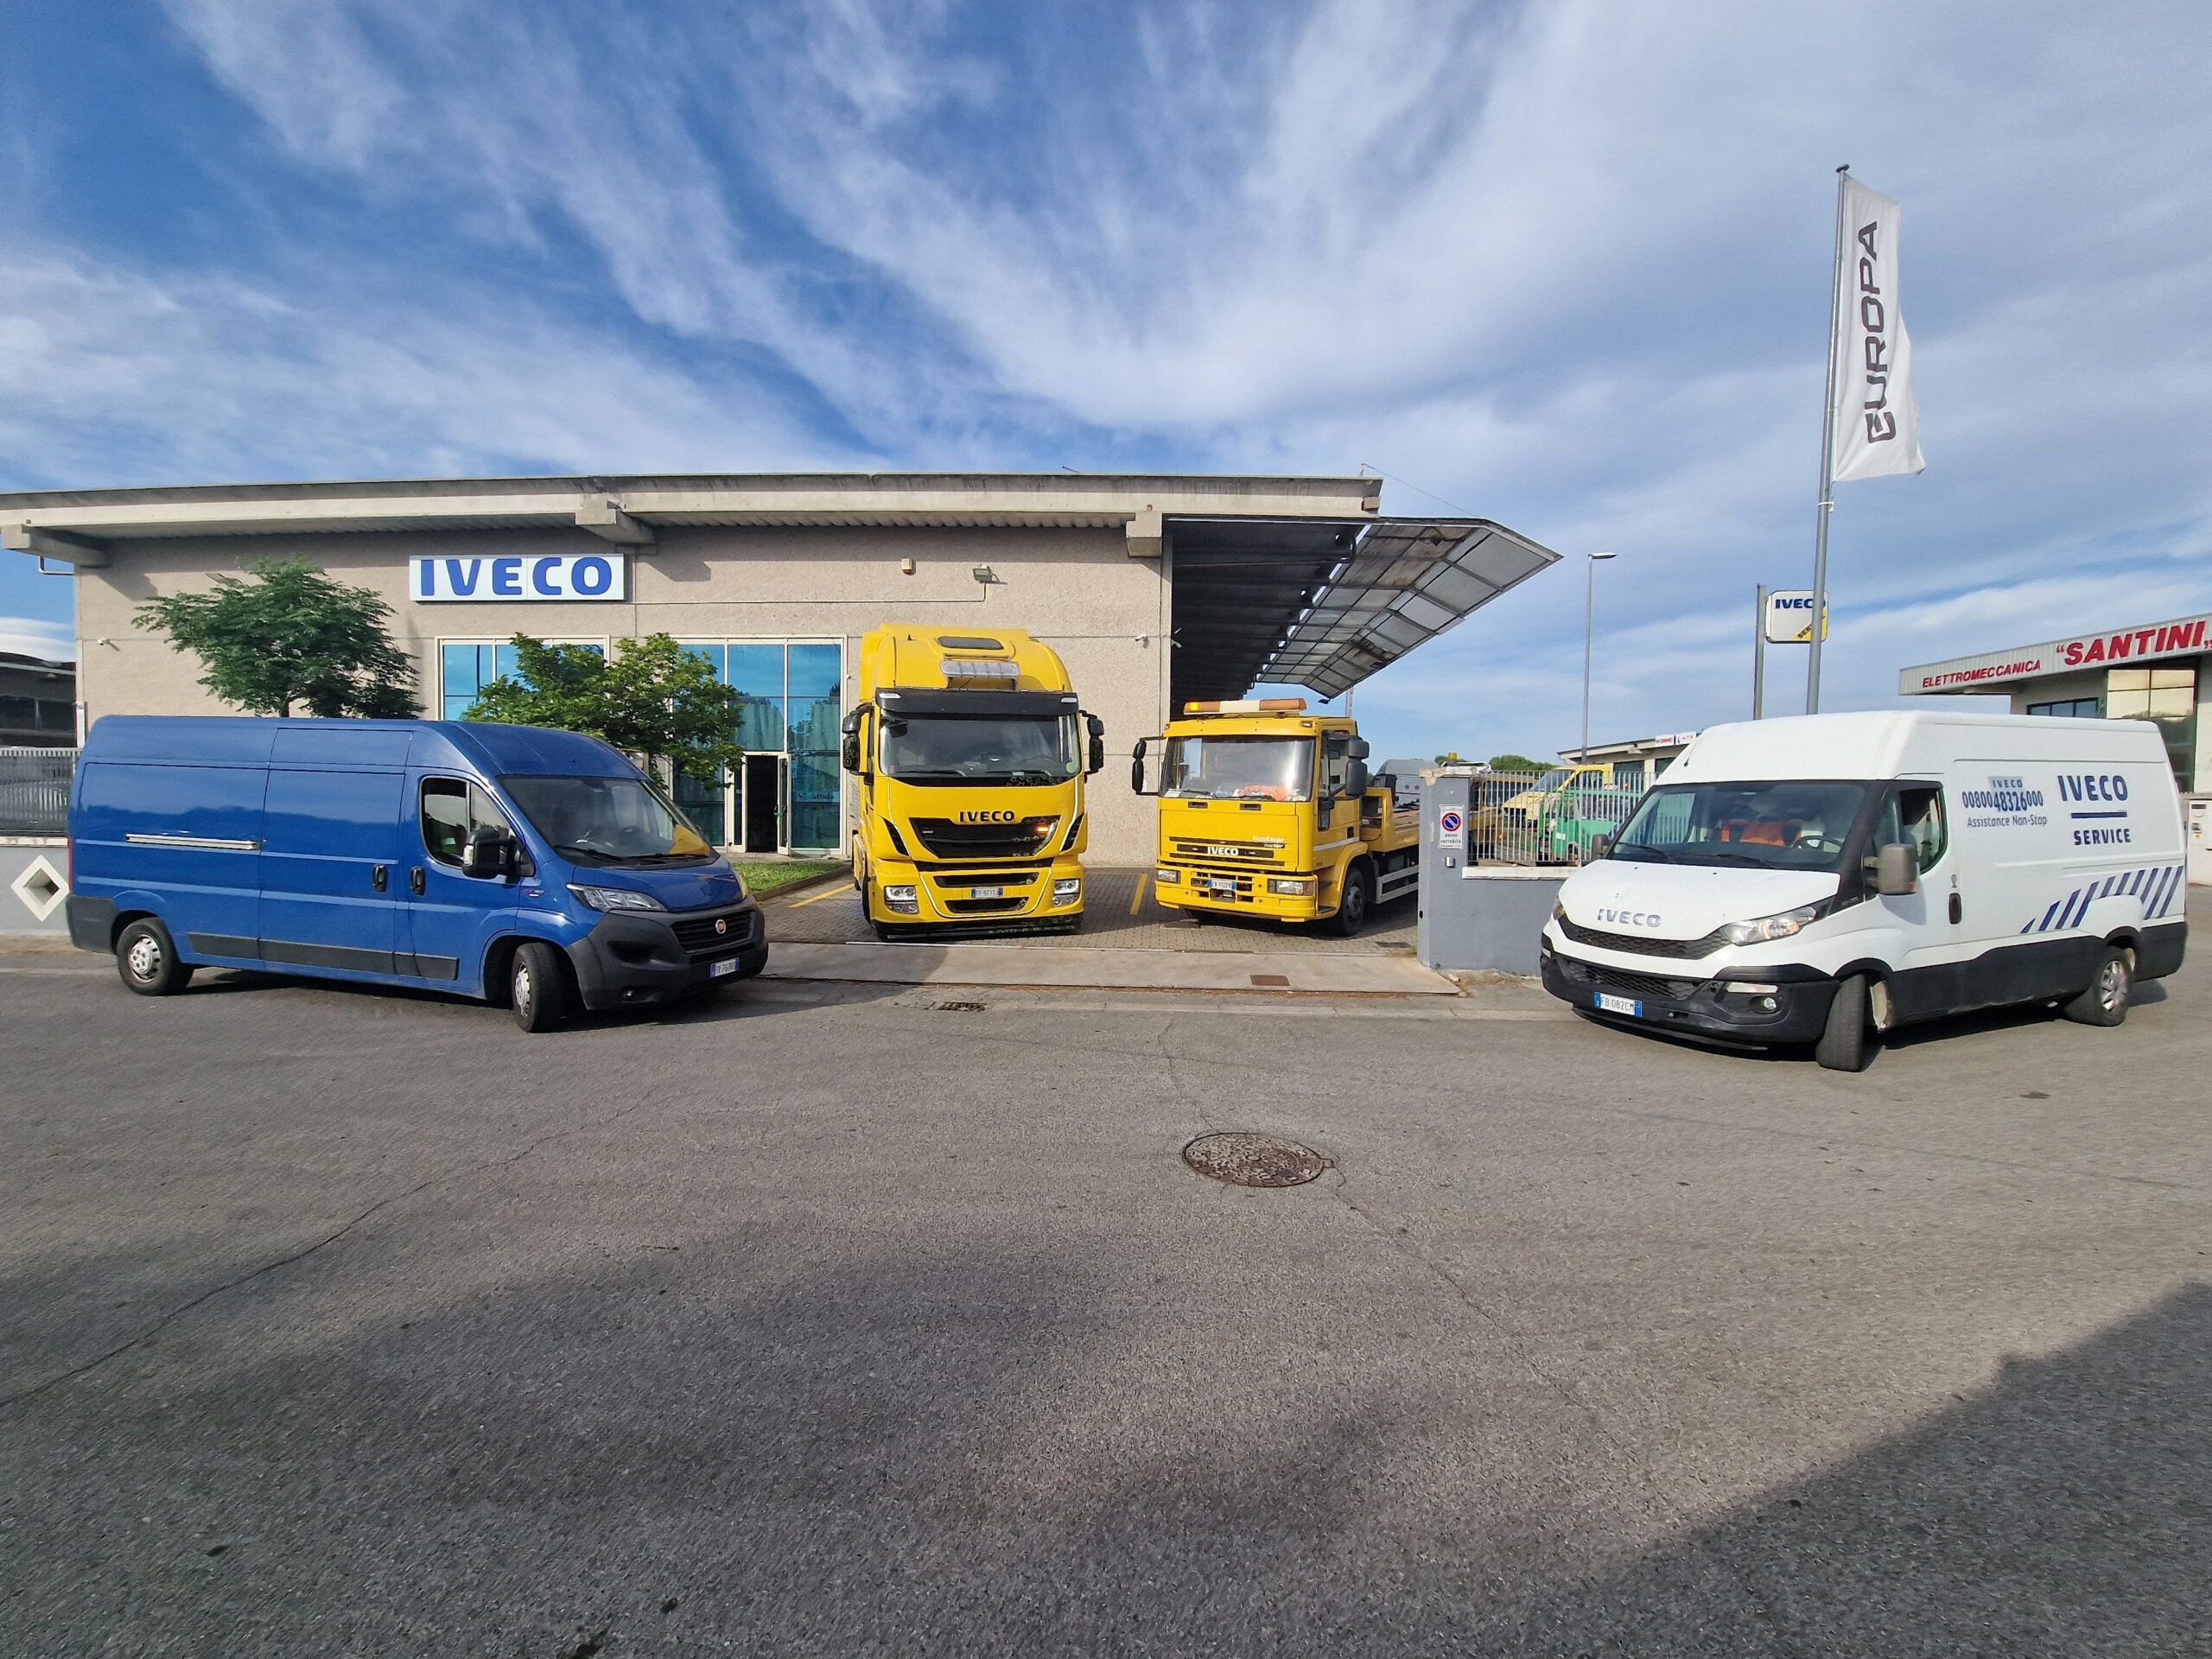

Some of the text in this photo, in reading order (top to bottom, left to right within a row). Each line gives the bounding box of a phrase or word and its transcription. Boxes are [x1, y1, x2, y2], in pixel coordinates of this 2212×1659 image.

[1858, 220, 1897, 443] EUROPA
[421, 556, 612, 596] IVECO
[1776, 599, 1826, 609] IVEC
[1922, 658, 2041, 688] ELETTROMECCANICA
[1993, 779, 2023, 788] IVECO
[2057, 775, 2128, 802] IVECO
[959, 810, 1015, 823] IVECO
[1967, 814, 2048, 828] Assistance Non-Stop
[2074, 828, 2131, 846] SERVICE
[1207, 846, 1239, 855] IVECO
[1598, 909, 1662, 927] IVECO
